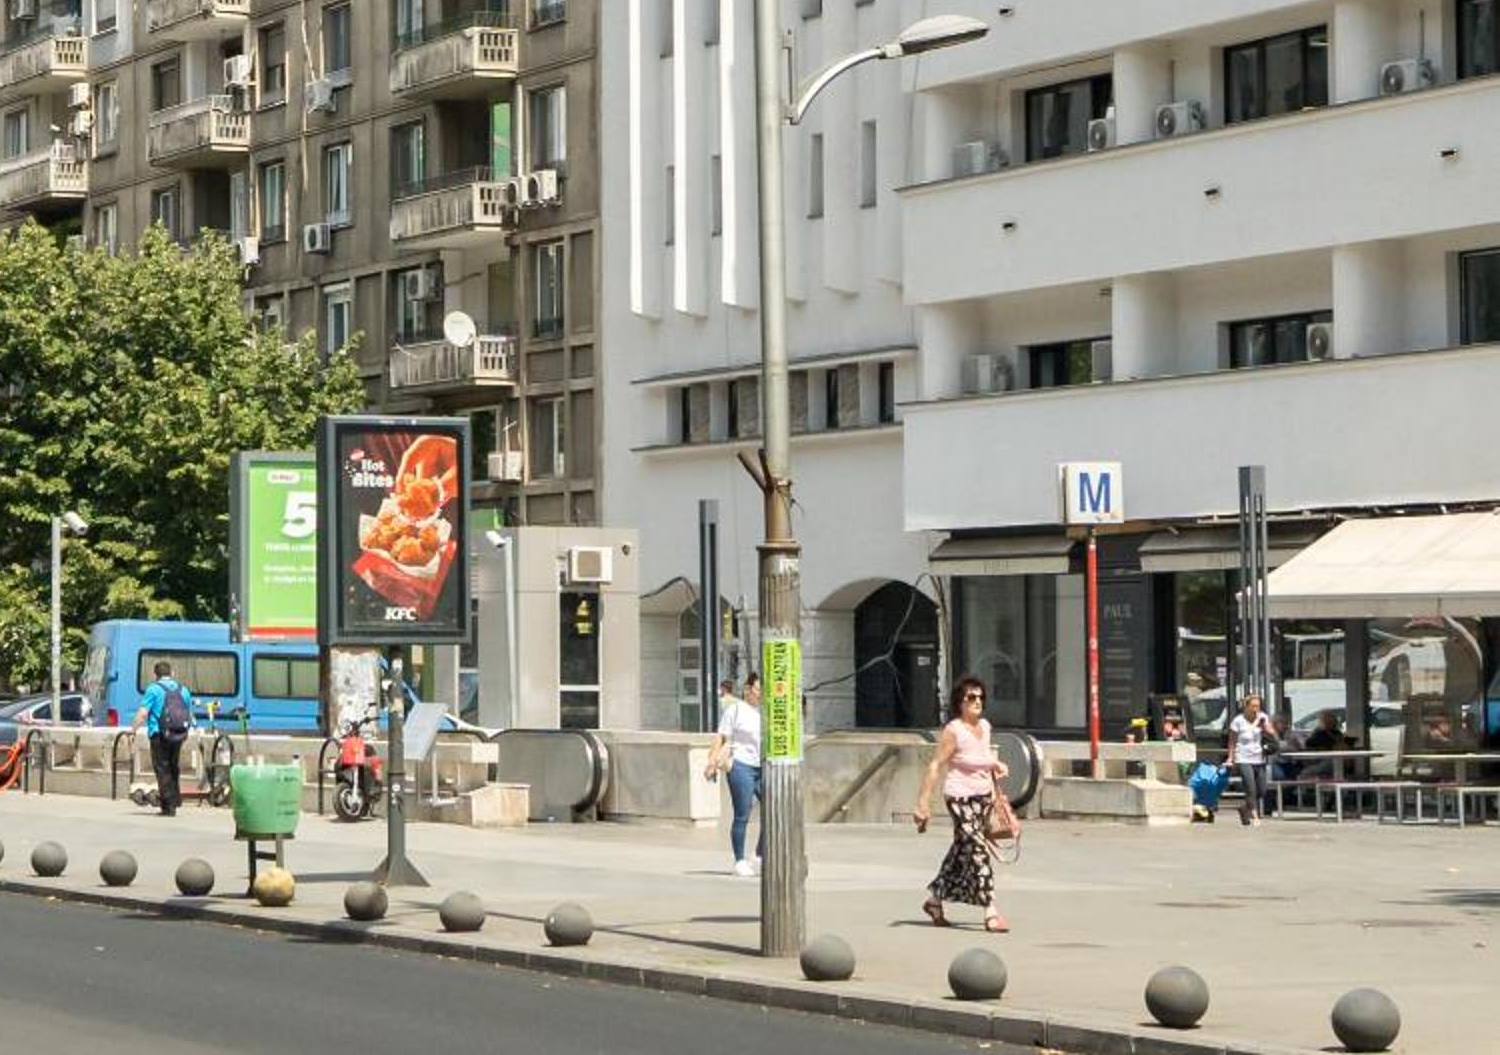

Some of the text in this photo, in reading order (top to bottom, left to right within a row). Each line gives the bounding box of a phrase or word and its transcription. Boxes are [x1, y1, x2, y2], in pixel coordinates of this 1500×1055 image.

[361, 459, 386, 472] Hot
[352, 472, 394, 488] Bites
[1080, 472, 1110, 513] M
[385, 607, 417, 621] KFC
